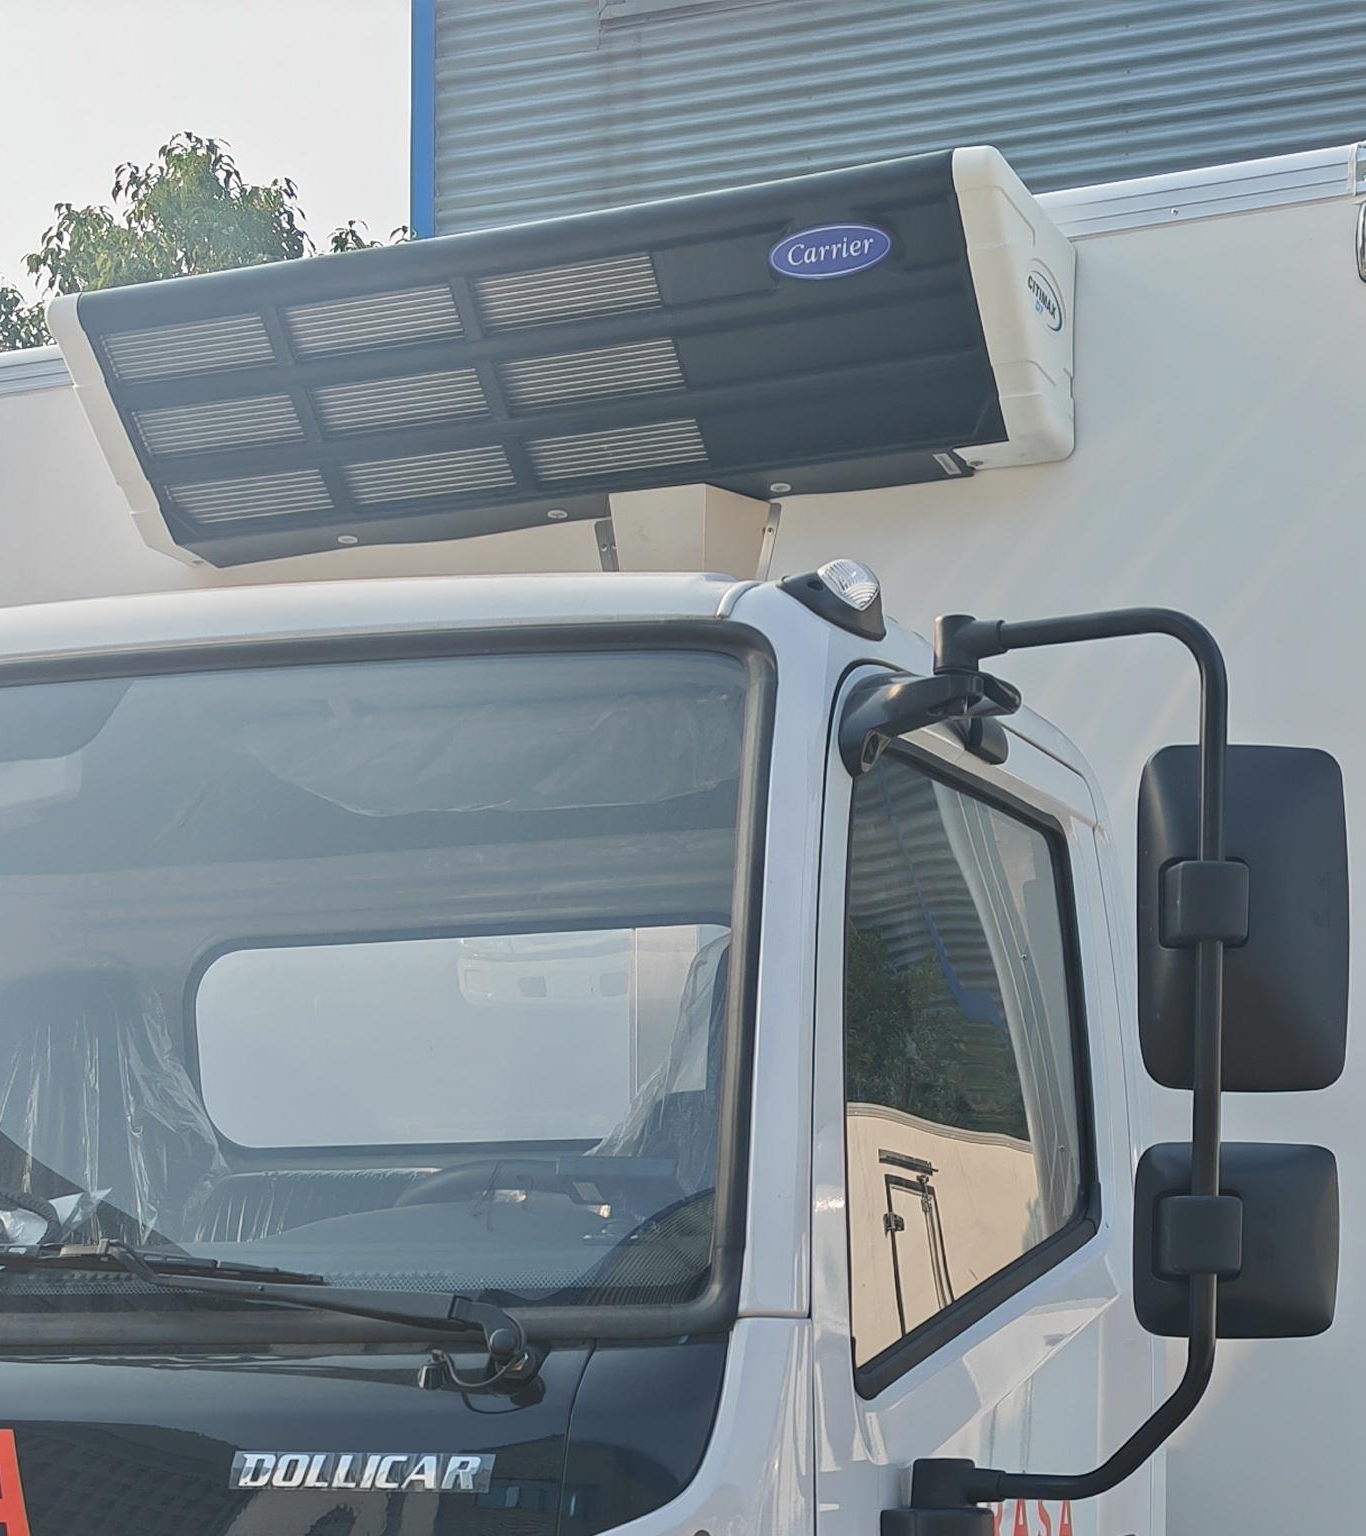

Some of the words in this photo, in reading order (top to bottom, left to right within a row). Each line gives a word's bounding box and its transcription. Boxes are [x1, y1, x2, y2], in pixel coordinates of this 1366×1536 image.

[787, 237, 874, 266] Carrier
[1027, 274, 1056, 320] CITIMAX
[238, 1453, 482, 1490] DOLLICAR
